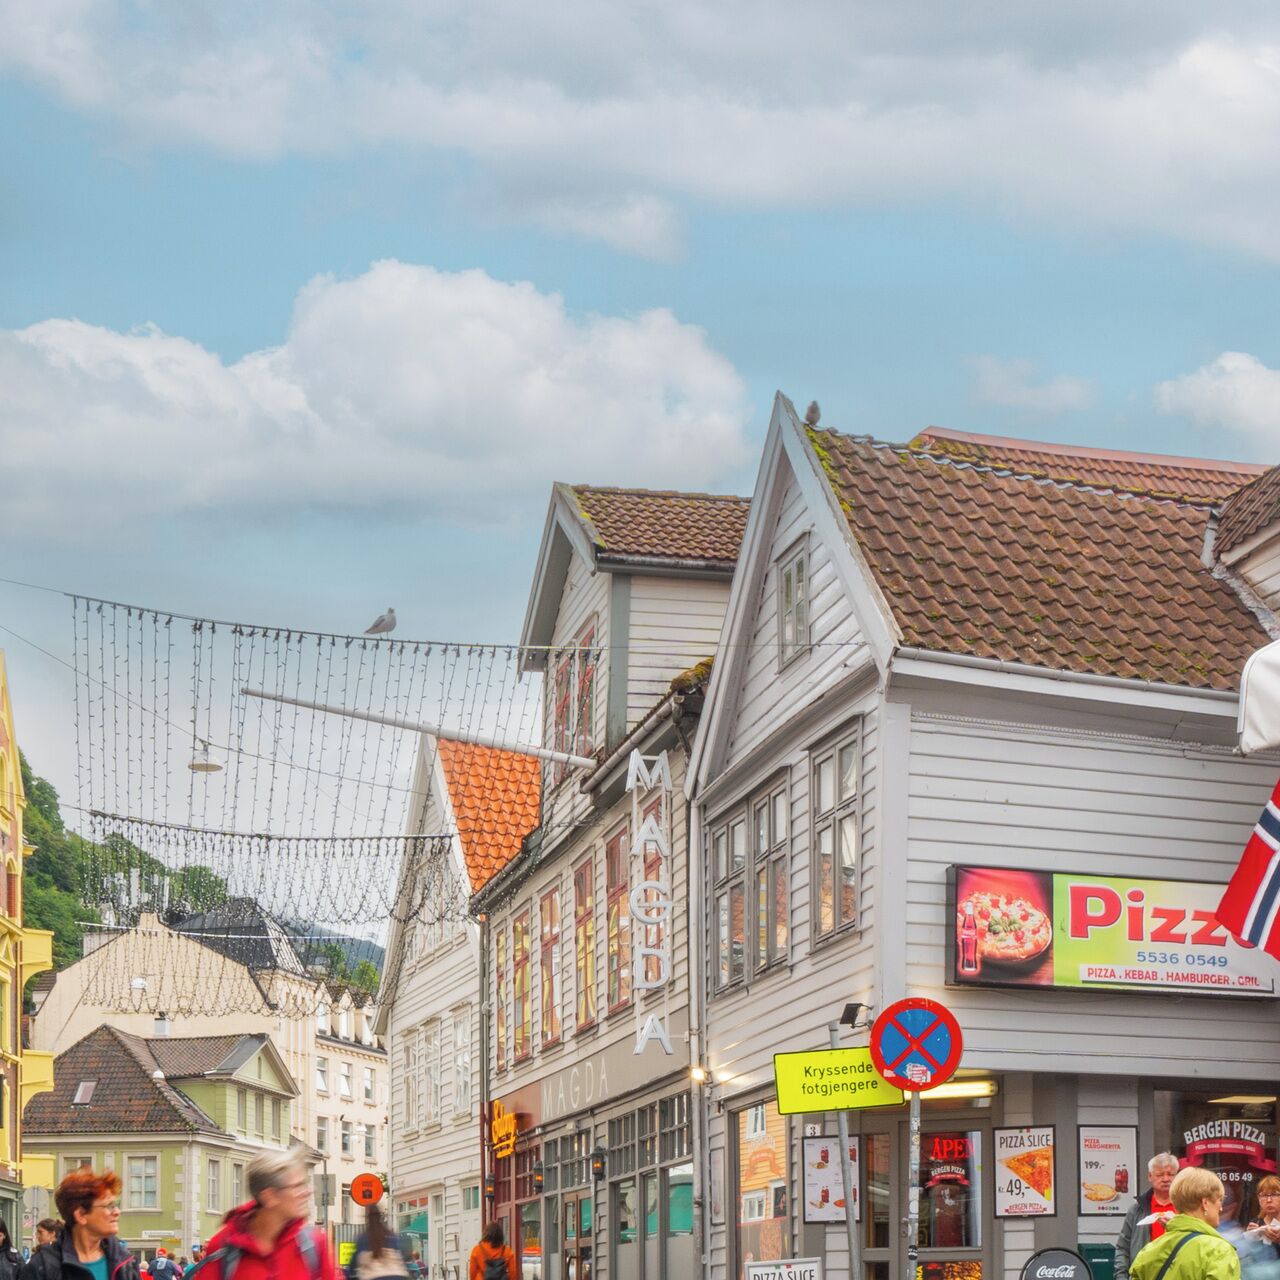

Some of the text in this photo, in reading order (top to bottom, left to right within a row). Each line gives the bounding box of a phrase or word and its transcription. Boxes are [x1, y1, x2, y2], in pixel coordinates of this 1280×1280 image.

[625, 748, 673, 1056] MAGDA
[1068, 882, 1260, 950] Pizz
[1136, 951, 1228, 968] 5536 0549
[1087, 967, 1116, 979] PIZZA
[1124, 969, 1158, 982] KEBAB
[1166, 972, 1230, 986] HAMBURGER
[804, 1061, 873, 1080] Kryssende
[542, 1055, 609, 1119] MAGDA
[801, 1079, 879, 1098] fotgjengere
[809, 1126, 817, 1137] 3
[1183, 1120, 1266, 1145] BERGEN PIZZA
[999, 1134, 1051, 1149] PIZZA SLICE
[1229, 1172, 1240, 1182] 05
[1241, 1172, 1253, 1182] 49
